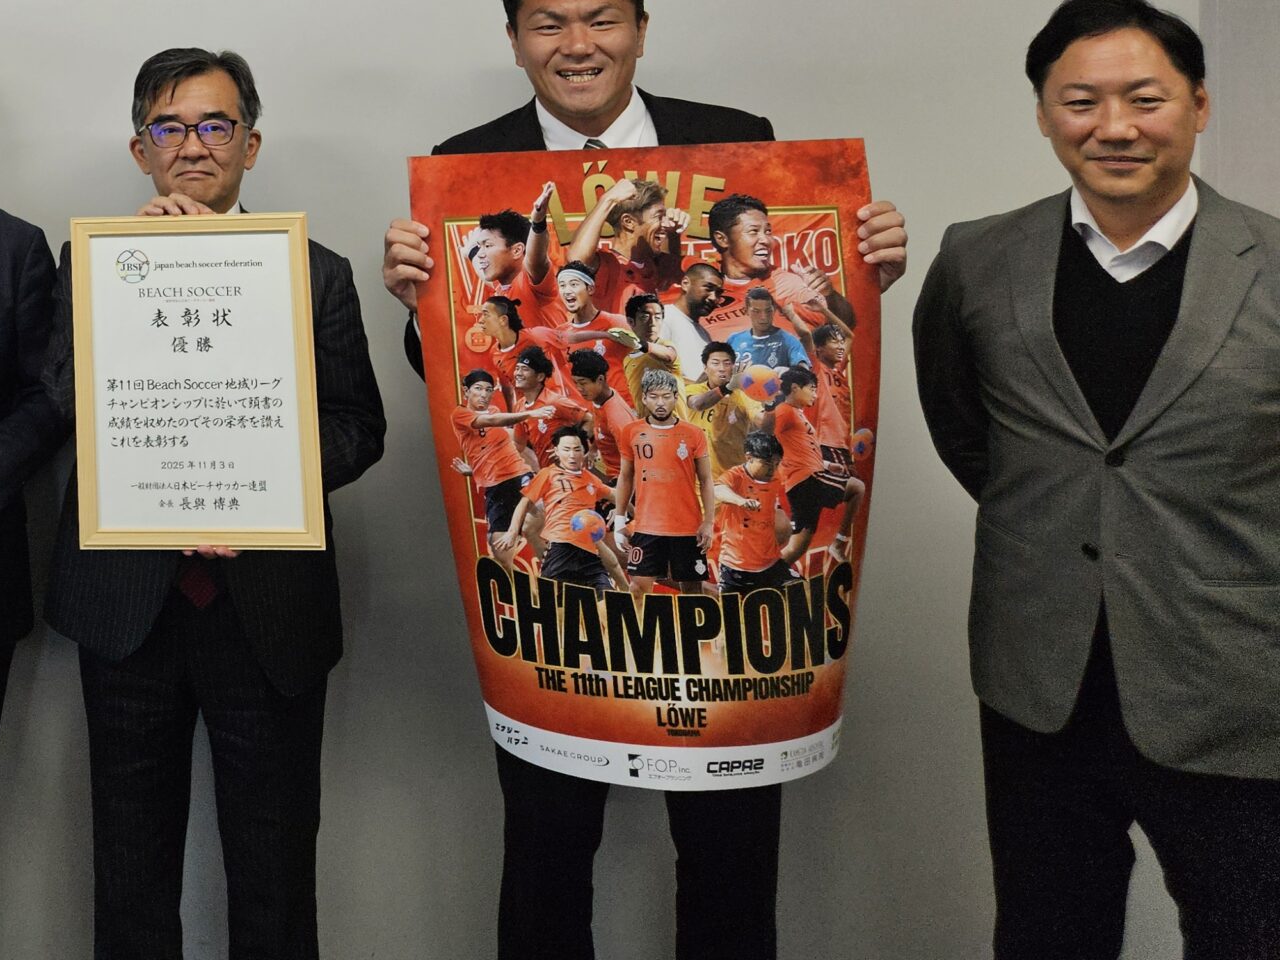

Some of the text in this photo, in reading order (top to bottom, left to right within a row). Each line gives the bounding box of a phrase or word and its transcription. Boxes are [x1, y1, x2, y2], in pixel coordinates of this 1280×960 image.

[153, 261, 175, 272] japan
[175, 260, 197, 269] beach
[223, 259, 263, 268] federation
[138, 285, 243, 299] BEACH SOCCER
[150, 308, 233, 328] 表彰状
[171, 336, 214, 354] 優勝
[147, 378, 182, 390] Beach
[183, 378, 223, 390] Soccer
[224, 377, 283, 390] 地域リーグ
[110, 434, 189, 449] これを表彰する
[634, 443, 654, 460] 10
[476, 555, 854, 676] CHAMPIONS
[534, 666, 815, 702] THE 11th LEAGUE CHAMPIONSHIP
[656, 703, 707, 728] LÖWE
[540, 744, 603, 764] SAKAE GROUP
